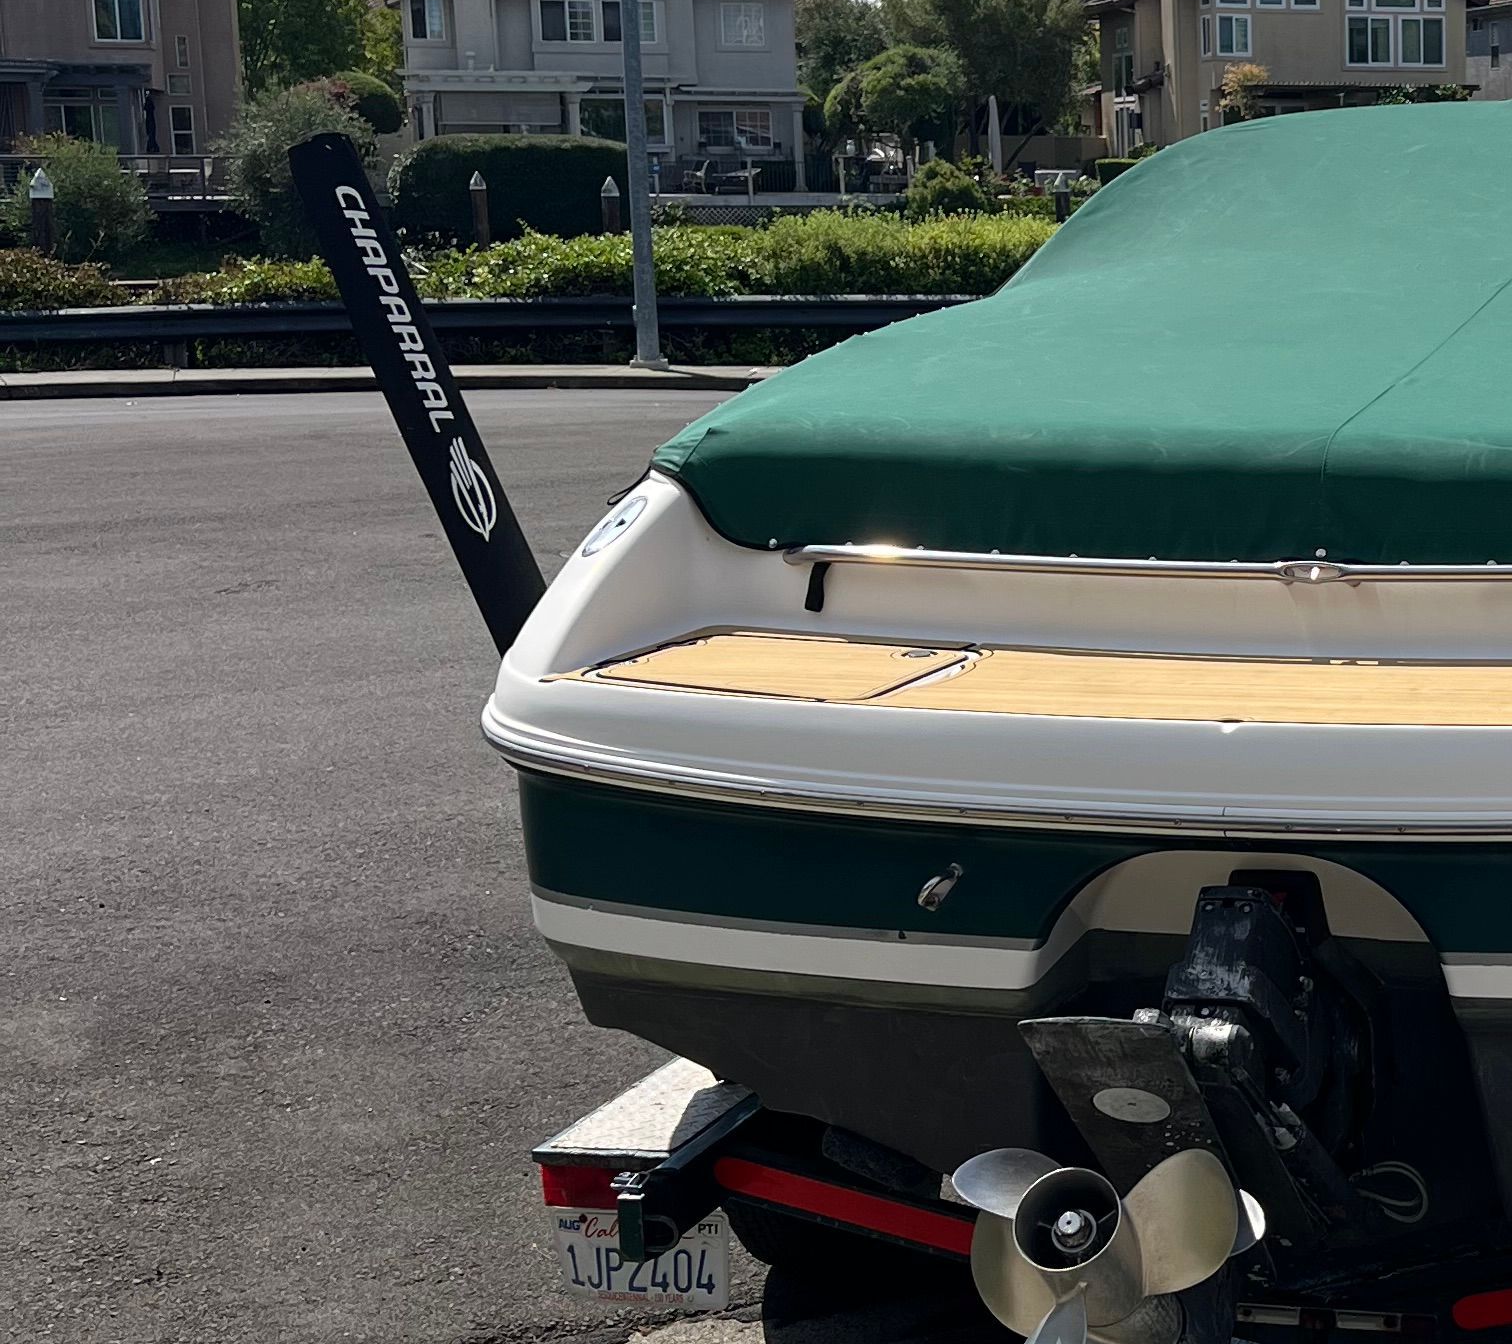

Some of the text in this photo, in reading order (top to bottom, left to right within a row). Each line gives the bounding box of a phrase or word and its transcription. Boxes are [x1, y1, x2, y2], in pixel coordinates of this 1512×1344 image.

[335, 185, 454, 433] CHAPARRAL
[558, 1218, 581, 1231] AUG
[697, 1223, 719, 1235] PTI
[567, 1244, 716, 1295] 1JP2404
